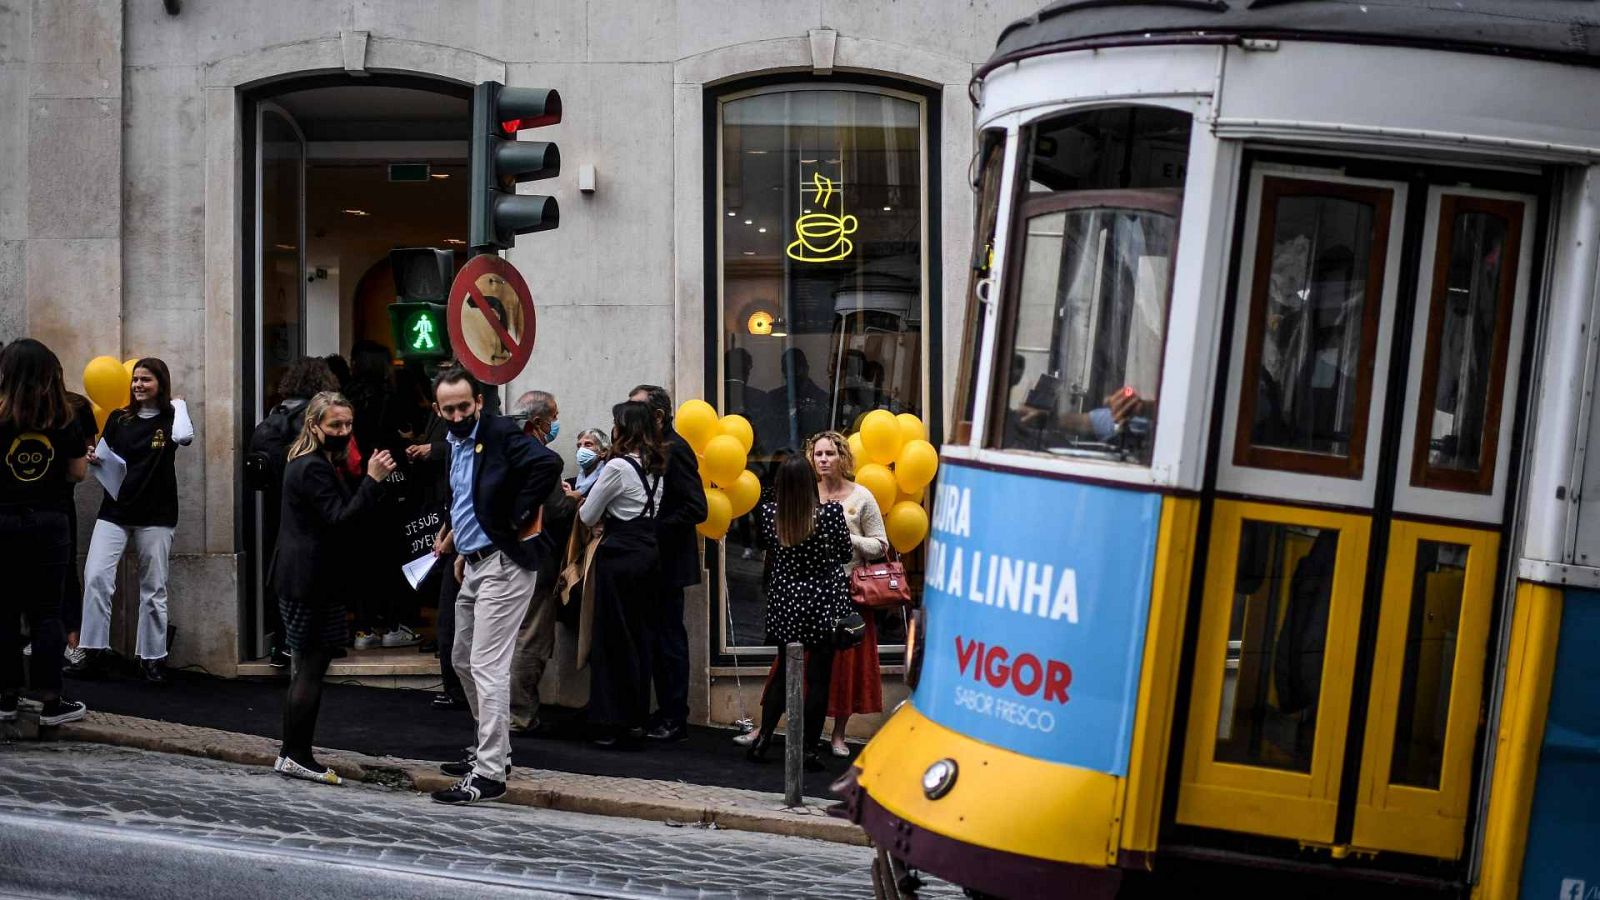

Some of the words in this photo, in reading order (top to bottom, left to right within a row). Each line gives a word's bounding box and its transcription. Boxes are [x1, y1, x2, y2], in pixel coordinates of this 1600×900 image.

[947, 547, 964, 598] A
[968, 551, 1079, 624] LINHA
[954, 634, 1073, 705] VIGOR
[955, 686, 994, 714] SABOR
[996, 697, 1055, 733] FRESCO
